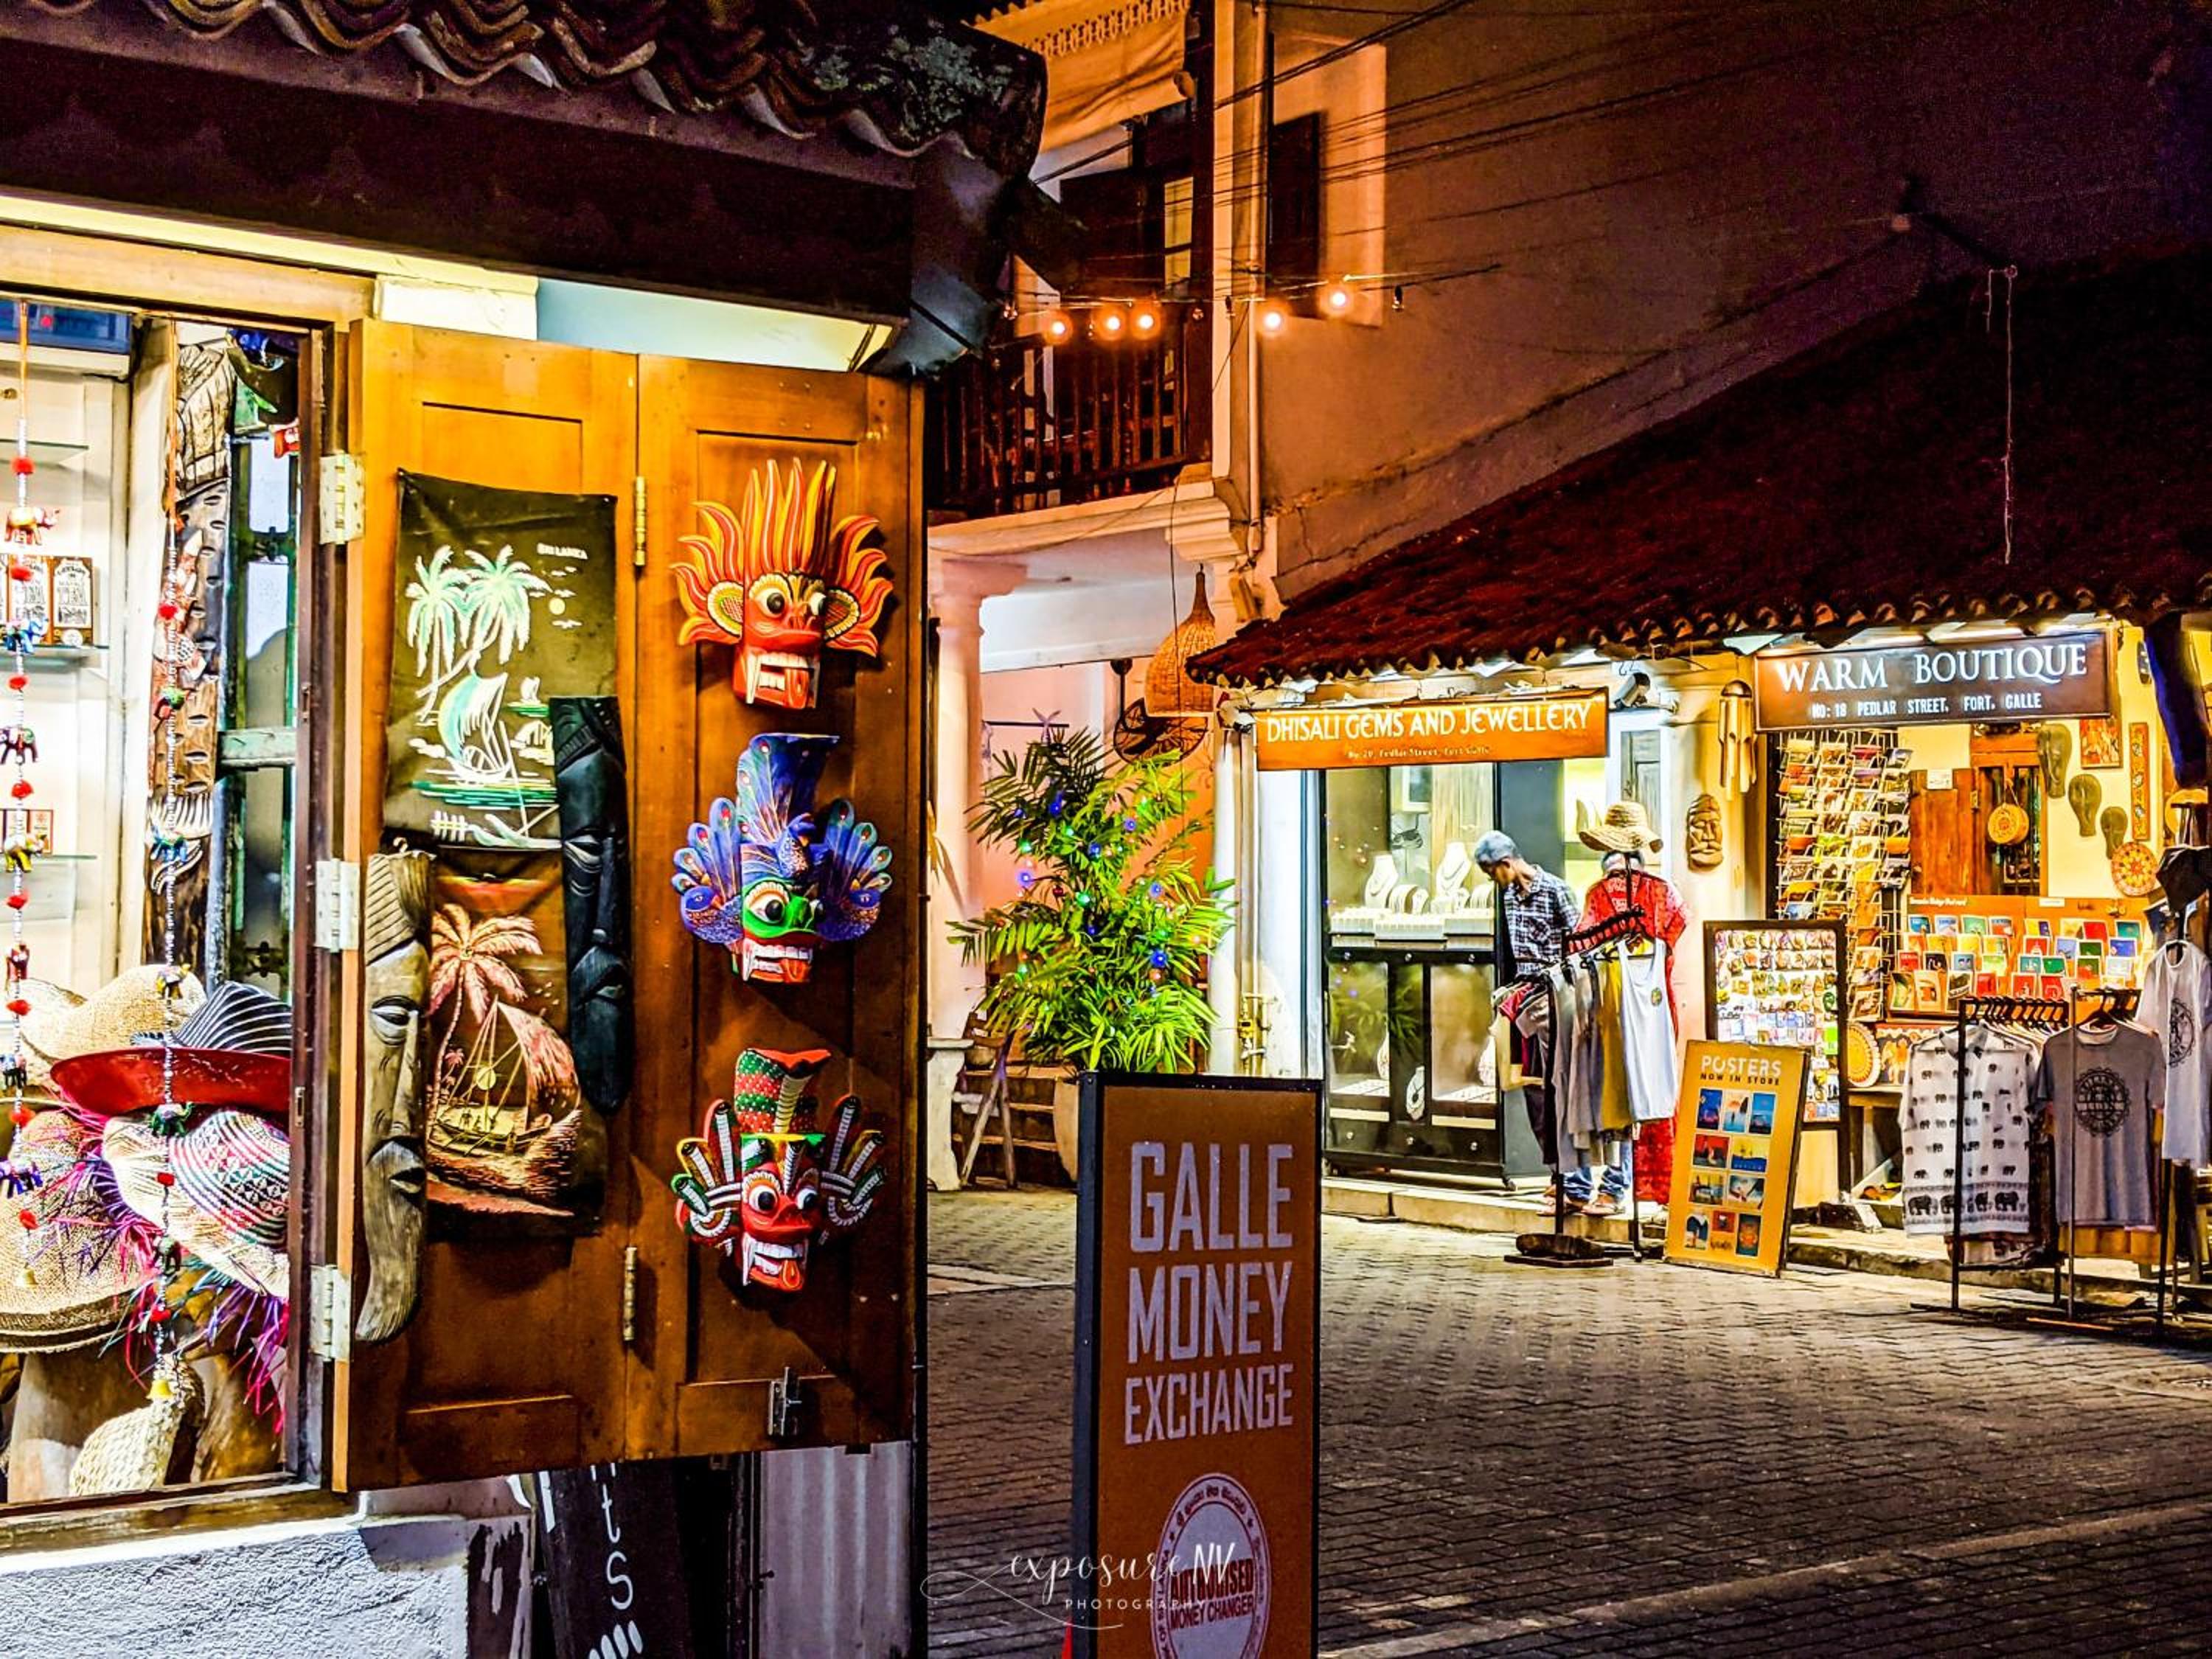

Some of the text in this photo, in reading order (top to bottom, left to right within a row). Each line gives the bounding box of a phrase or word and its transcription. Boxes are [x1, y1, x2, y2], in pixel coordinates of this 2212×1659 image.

[1775, 642, 2088, 693] WARM BOUTIQUE
[1266, 701, 1593, 743] DHISALI GEMS AND JEWELLERY
[1857, 700, 1897, 717] PEDLAR
[2005, 692, 2042, 710] GALLE
[1700, 1054, 1782, 1078] POSTERS
[1700, 1073, 1779, 1086] NOW IN STORE
[1129, 1140, 1295, 1253] GALLE
[1127, 1259, 1294, 1364] MONEY
[1124, 1362, 1295, 1446] EXCHANGE
[1206, 1594, 1254, 1623] CHANGER
